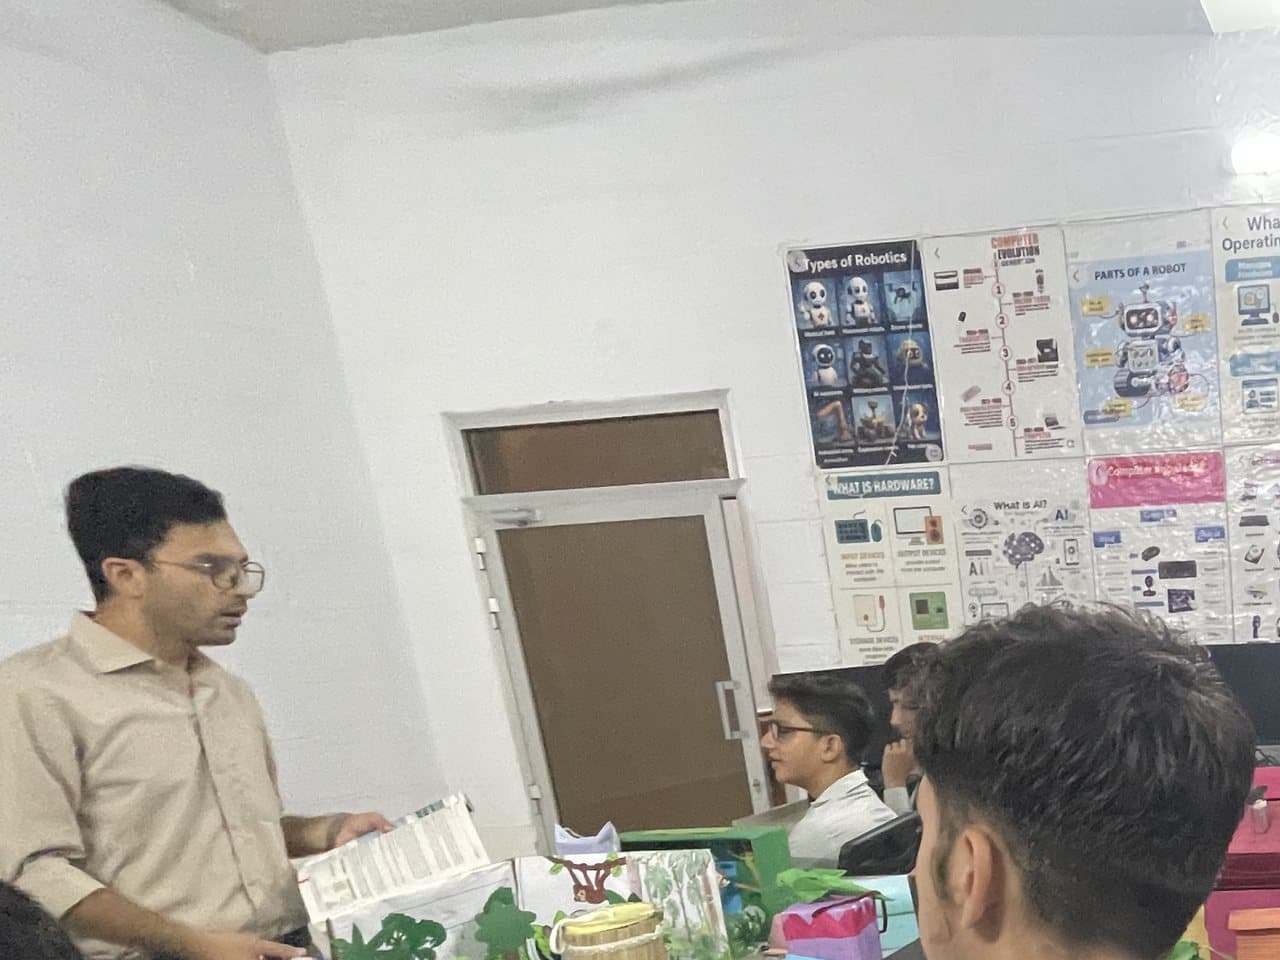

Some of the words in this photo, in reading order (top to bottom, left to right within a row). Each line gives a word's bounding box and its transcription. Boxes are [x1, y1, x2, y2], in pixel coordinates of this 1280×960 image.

[803, 256, 838, 273] Types
[841, 254, 852, 267] of
[855, 251, 908, 266] Robotics
[1094, 269, 1125, 280] PARTS
[1128, 267, 1140, 276] OF
[1143, 266, 1150, 276] A
[1152, 263, 1187, 275] ROBOT
[996, 285, 1002, 294] 1
[1000, 316, 1005, 324] 2
[1002, 348, 1008, 358] 3
[1006, 382, 1012, 390] 4
[1010, 418, 1016, 427] 5
[832, 482, 860, 495] WHAT
[862, 482, 872, 494] IS
[874, 478, 934, 492] HARDWARE?
[1056, 510, 1068, 520] AI
